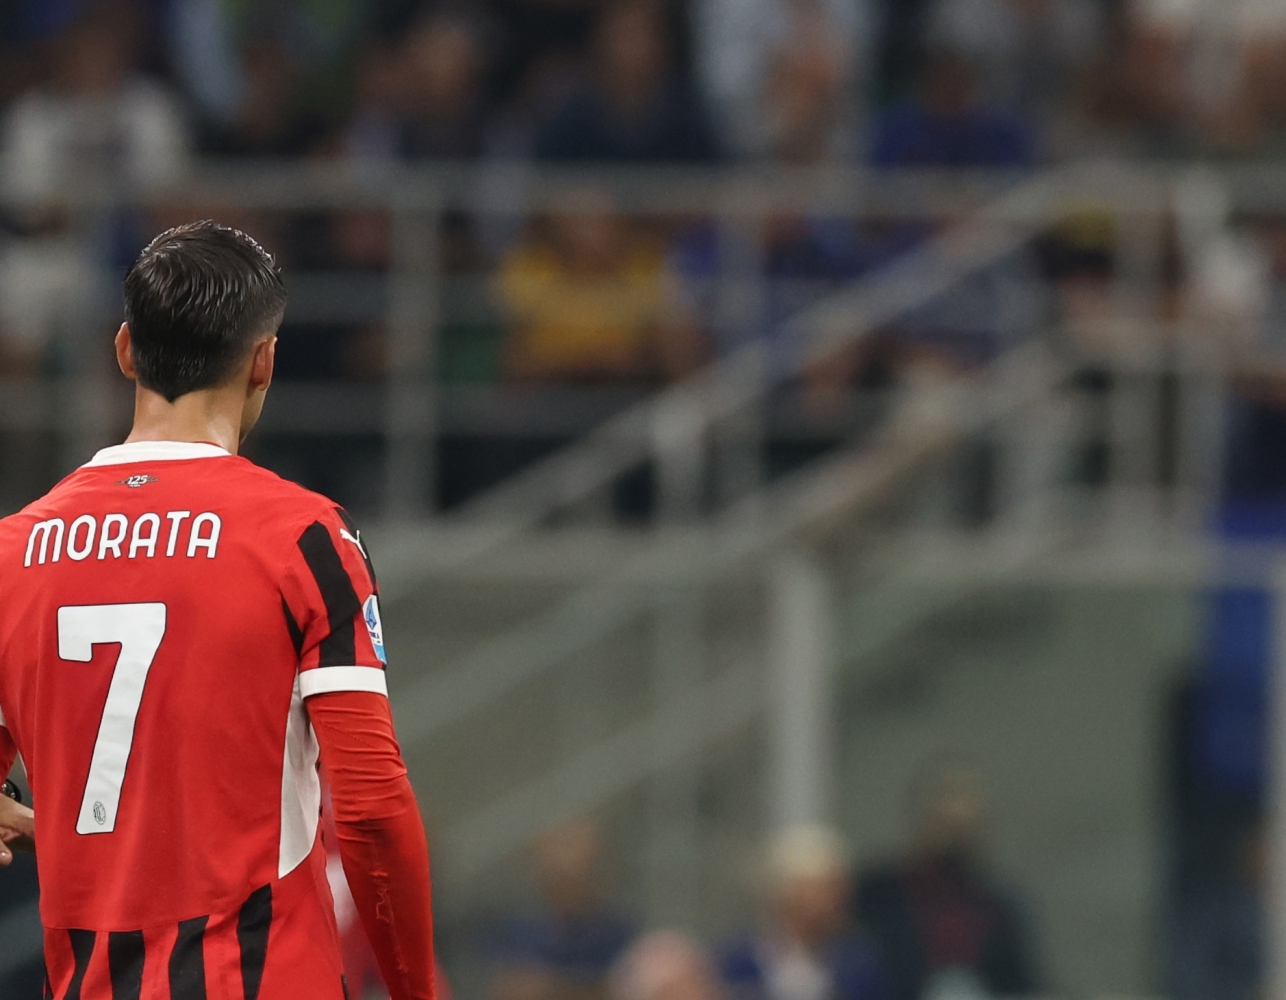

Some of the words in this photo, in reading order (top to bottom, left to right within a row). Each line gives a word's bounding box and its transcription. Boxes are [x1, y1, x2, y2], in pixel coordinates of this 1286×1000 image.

[127, 474, 149, 485] 125
[24, 511, 222, 568] MORATA
[57, 602, 167, 835] 7
